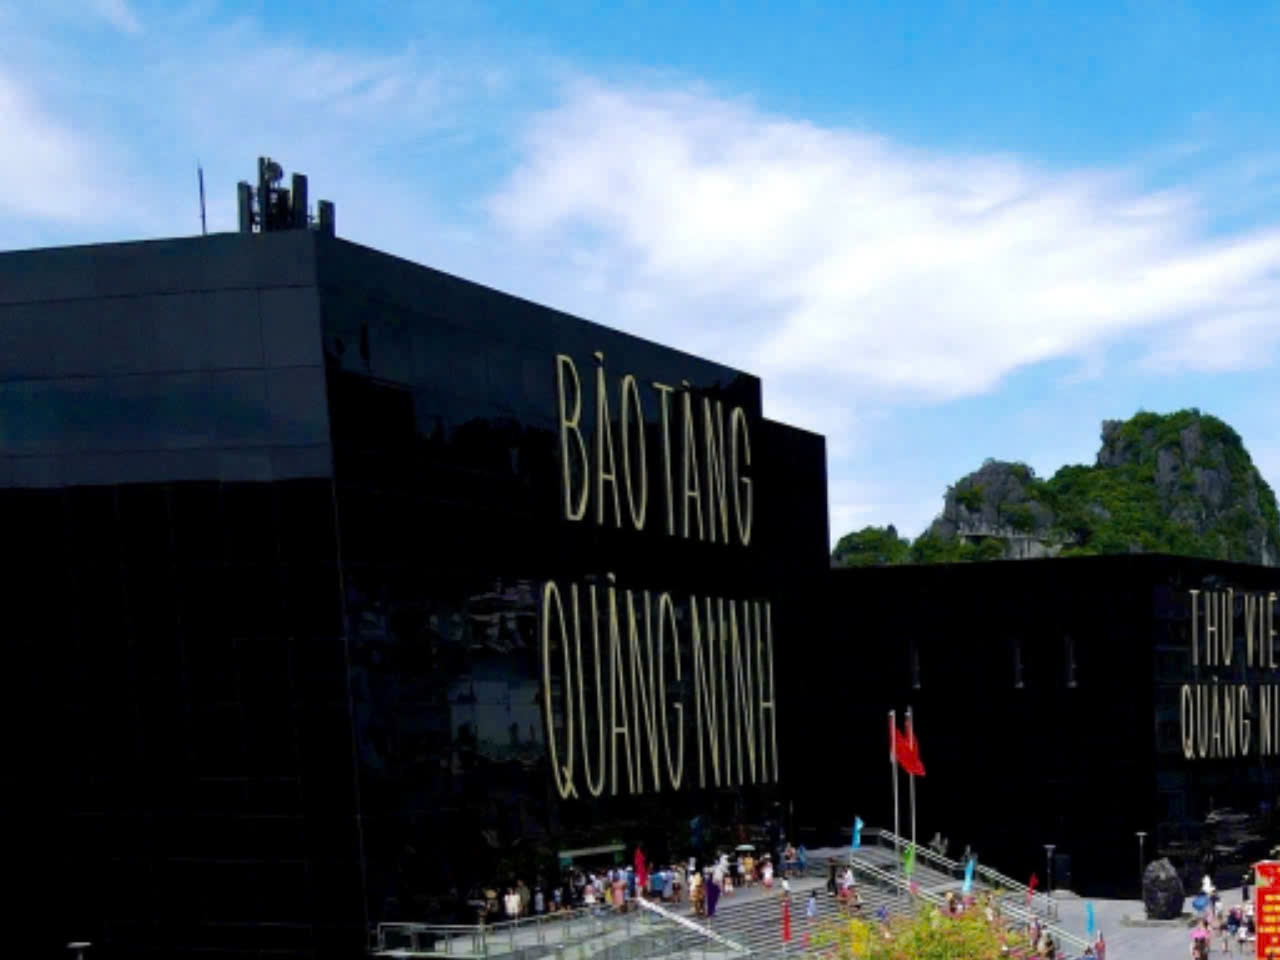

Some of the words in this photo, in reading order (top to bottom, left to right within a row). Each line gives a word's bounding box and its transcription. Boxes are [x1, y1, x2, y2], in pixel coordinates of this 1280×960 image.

[541, 572, 684, 800] QUẢNG
[690, 594, 779, 789] NINH
[1181, 674, 1251, 760] QUẢNG
